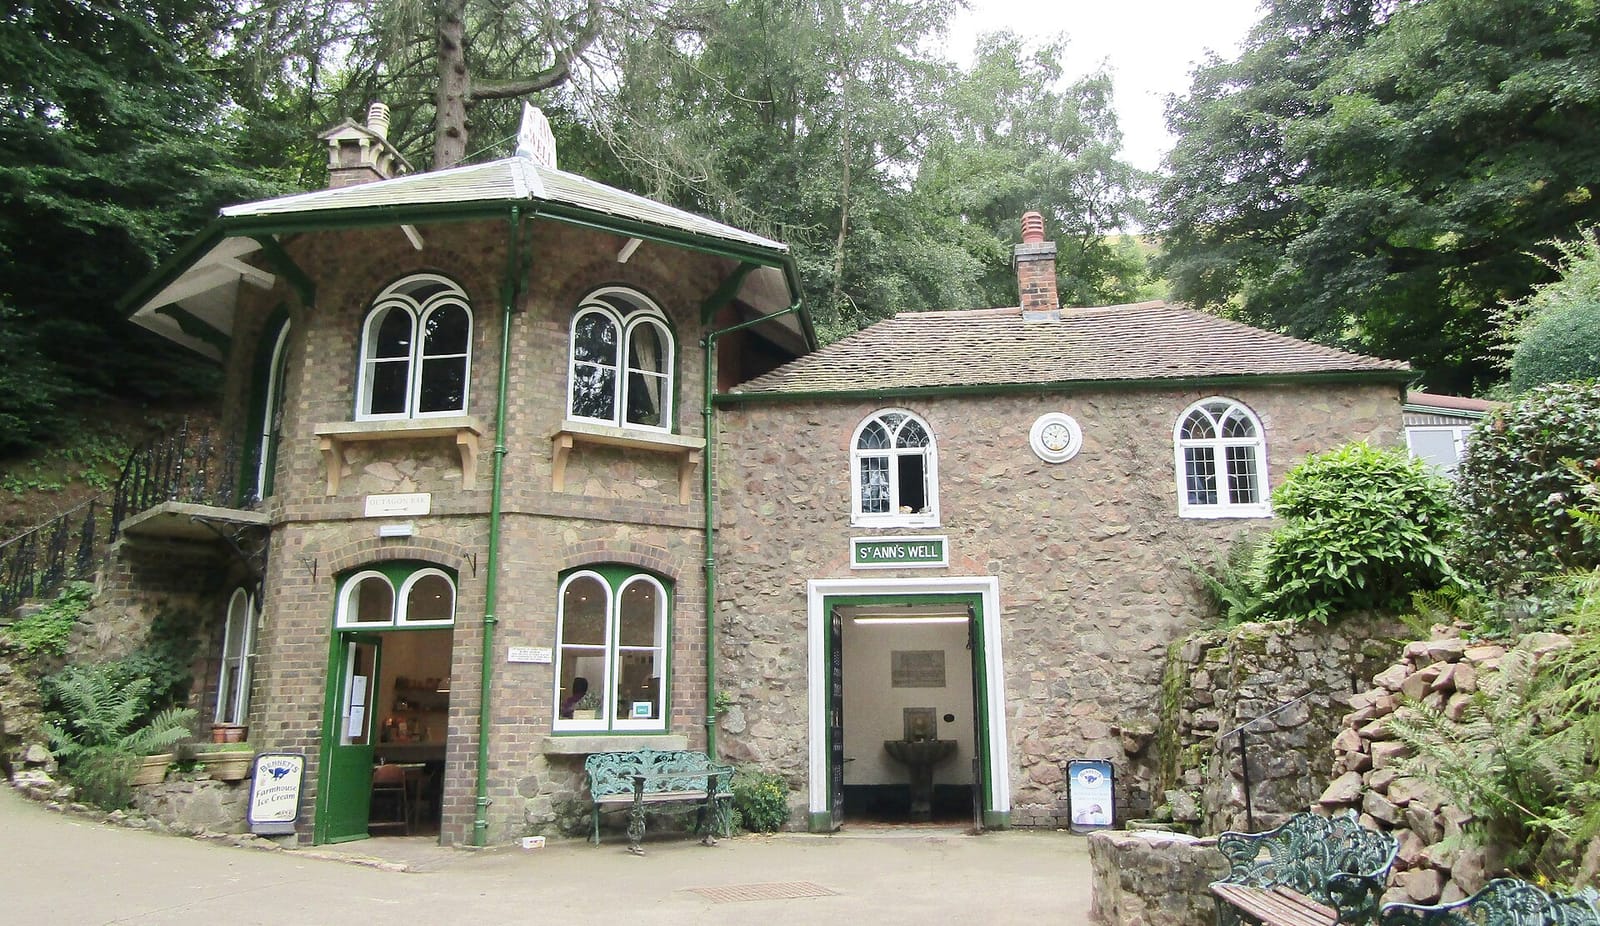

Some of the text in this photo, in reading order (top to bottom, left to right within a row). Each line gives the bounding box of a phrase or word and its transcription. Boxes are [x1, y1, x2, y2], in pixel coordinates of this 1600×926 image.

[873, 544, 905, 559] ANN'S
[908, 545, 938, 558] WELL
[256, 785, 296, 798] Farmhouse
[257, 793, 295, 807] Ice Cream
